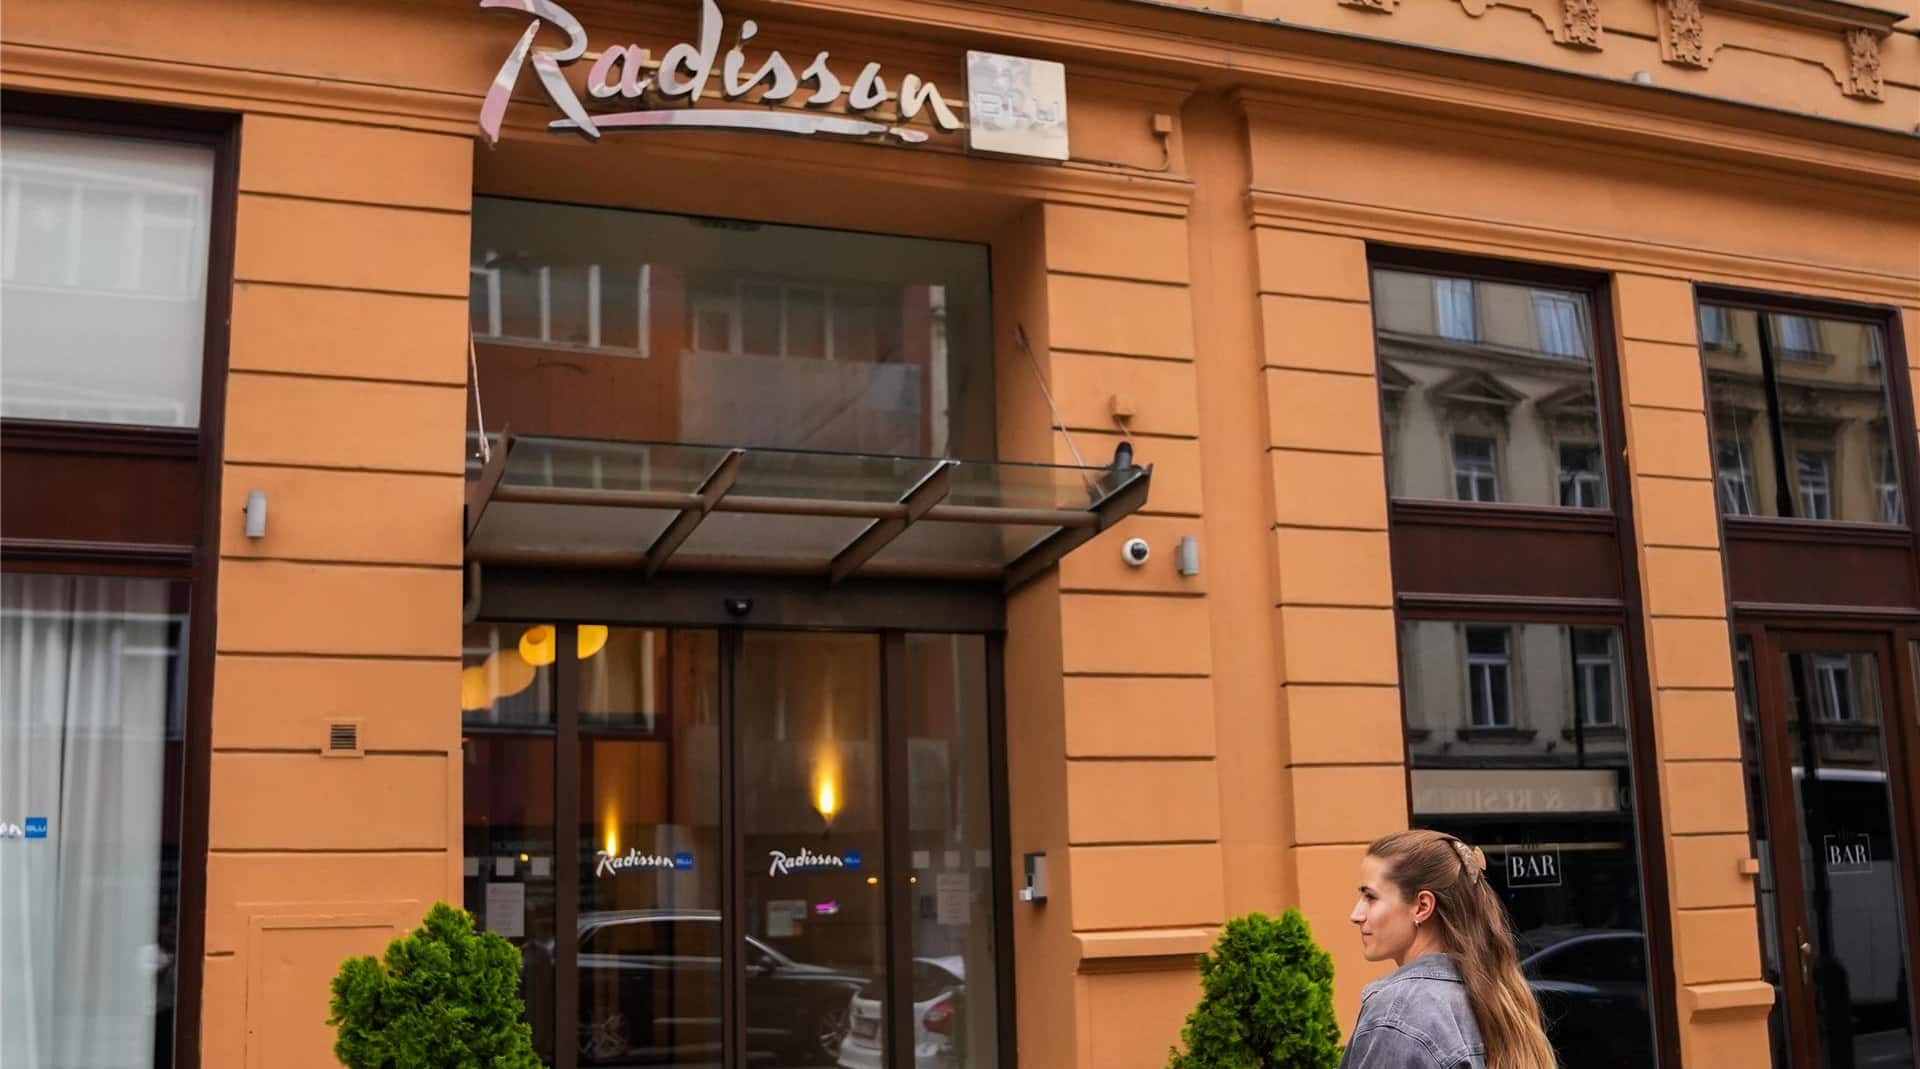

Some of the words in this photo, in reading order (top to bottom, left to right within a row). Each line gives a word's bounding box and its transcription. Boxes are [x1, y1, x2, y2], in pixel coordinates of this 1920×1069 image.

[479, 0, 962, 150] Radisson
[596, 848, 675, 878] Radisson
[768, 847, 843, 877] Radisson
[1511, 854, 1557, 878] BAR
[1829, 844, 1867, 865] BAR
